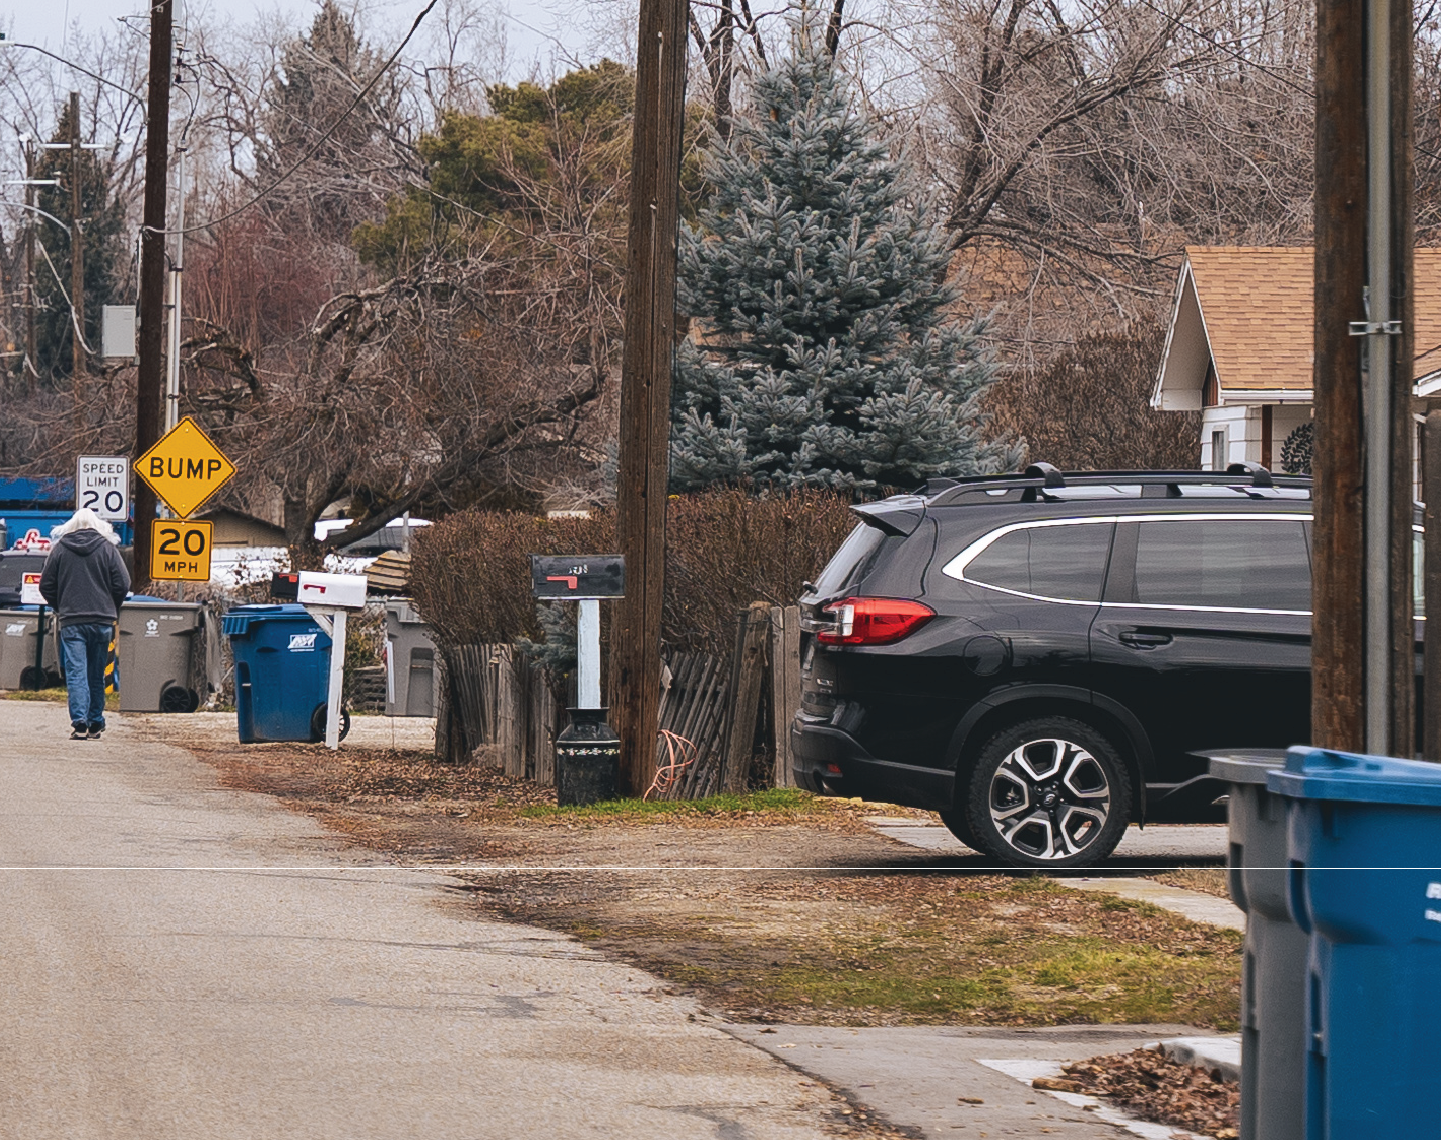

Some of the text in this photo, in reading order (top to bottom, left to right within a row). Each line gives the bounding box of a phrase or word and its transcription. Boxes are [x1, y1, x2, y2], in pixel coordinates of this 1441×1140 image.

[82, 463, 124, 474] SPEED
[149, 456, 222, 480] BUMP
[86, 476, 119, 487] LIMIT
[83, 490, 124, 513] 20
[158, 528, 205, 557] 20
[163, 561, 198, 573] MPH
